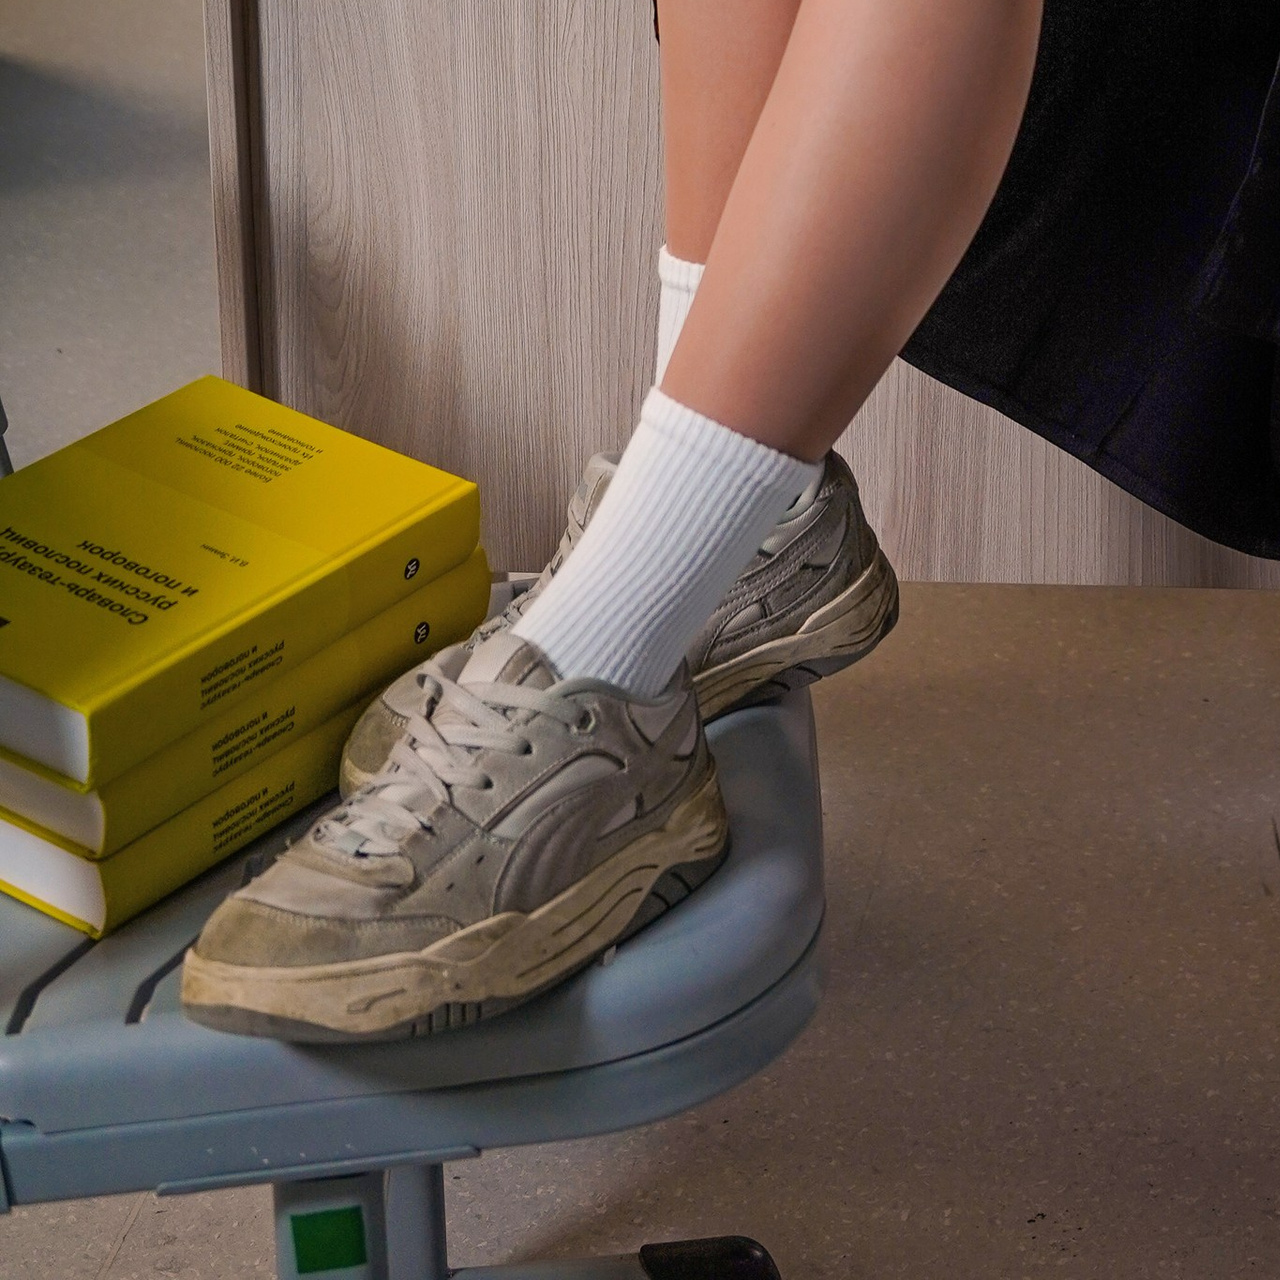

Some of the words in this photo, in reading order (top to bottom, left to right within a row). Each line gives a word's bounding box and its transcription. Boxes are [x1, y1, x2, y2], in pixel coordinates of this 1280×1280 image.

[0, 526, 94, 576] пословиц
[77, 540, 183, 590] поговорок
[0, 545, 149, 626] Словарь-тезаур
[91, 571, 178, 611] русских
[182, 586, 199, 598] и
[201, 650, 250, 683] поговорок
[248, 640, 284, 668] русских
[252, 645, 258, 654] и
[200, 655, 283, 710] Словарь-тезаурус
[201, 666, 246, 697] пословиц
[260, 705, 295, 734] русских
[262, 711, 268, 720] и
[212, 717, 260, 752] поговорок
[212, 721, 294, 778] Словарь-тезаурус
[213, 732, 258, 764] пословиц
[213, 792, 260, 828] поговорок
